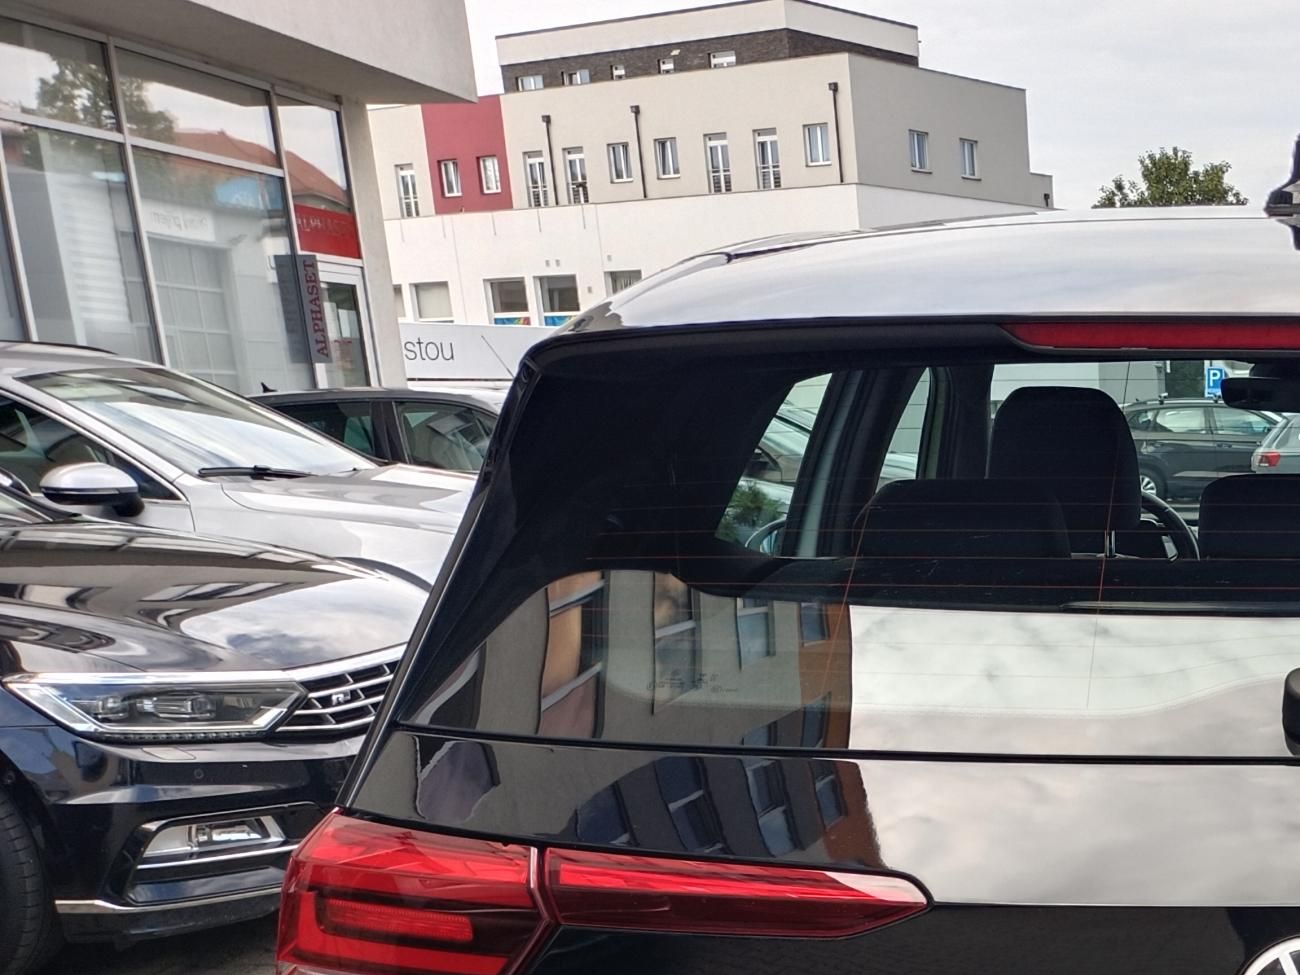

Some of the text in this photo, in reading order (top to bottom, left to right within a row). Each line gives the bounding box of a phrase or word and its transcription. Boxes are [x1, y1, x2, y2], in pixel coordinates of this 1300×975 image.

[303, 260, 329, 357] ALPHASET
[404, 336, 455, 361] stou
[1210, 369, 1221, 387] P
